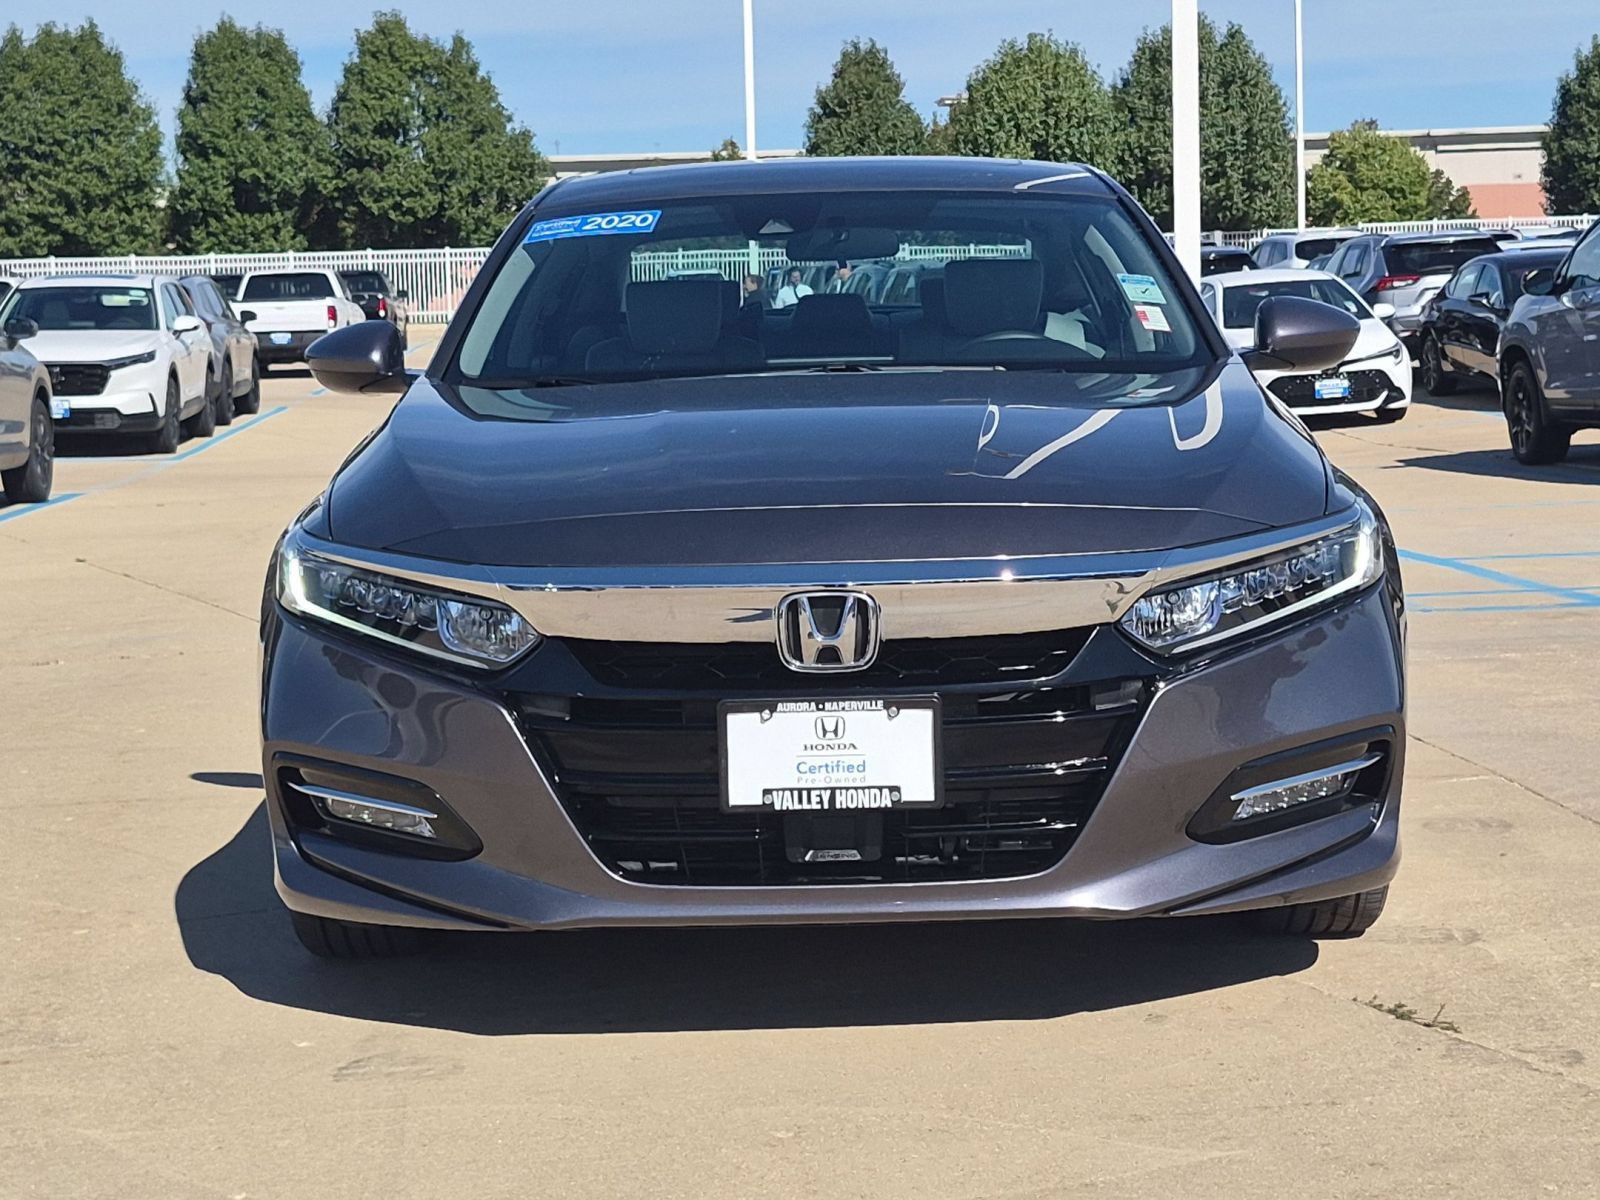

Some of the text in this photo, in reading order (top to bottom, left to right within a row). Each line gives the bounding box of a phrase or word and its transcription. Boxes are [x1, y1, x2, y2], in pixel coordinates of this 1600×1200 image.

[582, 213, 654, 231] 2020
[776, 700, 884, 712] AURORA NAPERVILLE
[803, 743, 858, 751] HONDA
[796, 760, 866, 774] Certified
[797, 775, 866, 785] Pre-Owned
[772, 788, 892, 810] VALLEY HONDA
